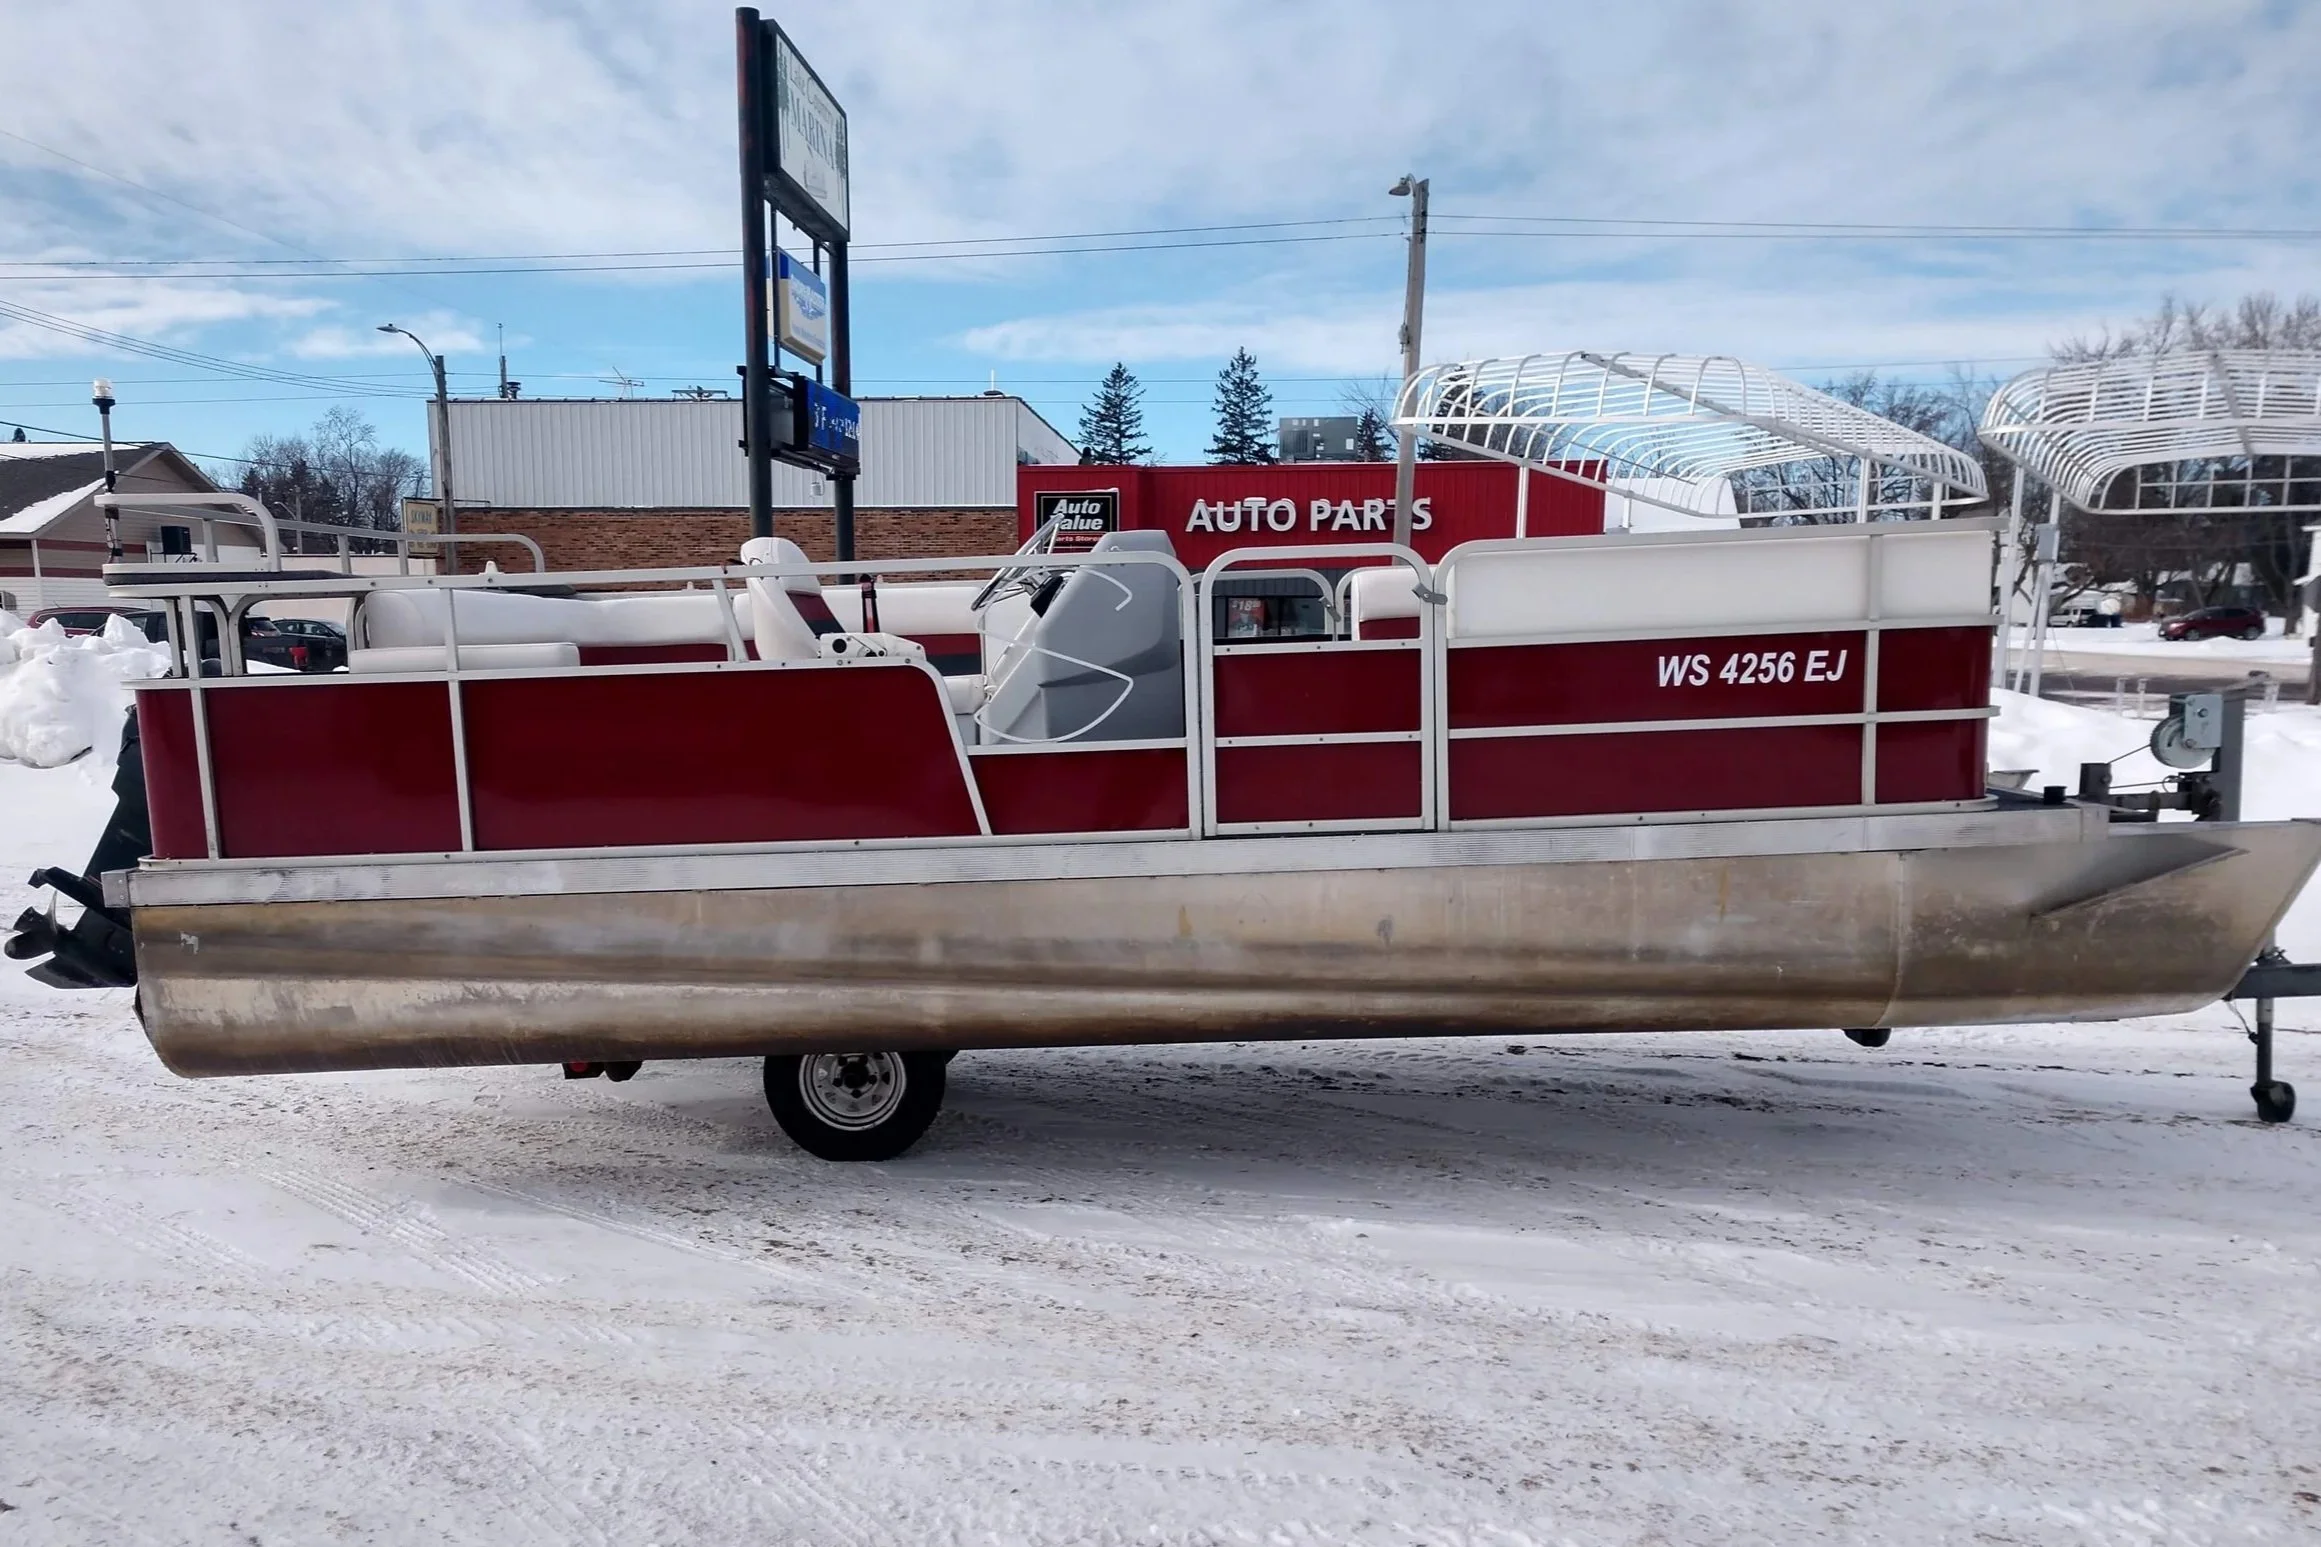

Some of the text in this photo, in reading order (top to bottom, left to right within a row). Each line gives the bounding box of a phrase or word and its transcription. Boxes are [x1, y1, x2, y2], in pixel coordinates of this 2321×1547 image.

[1053, 499, 1101, 515] Auto
[1185, 498, 1297, 532] AUTO
[1049, 515, 1103, 530] alue
[1658, 650, 1848, 687] WS 4256 EJ
